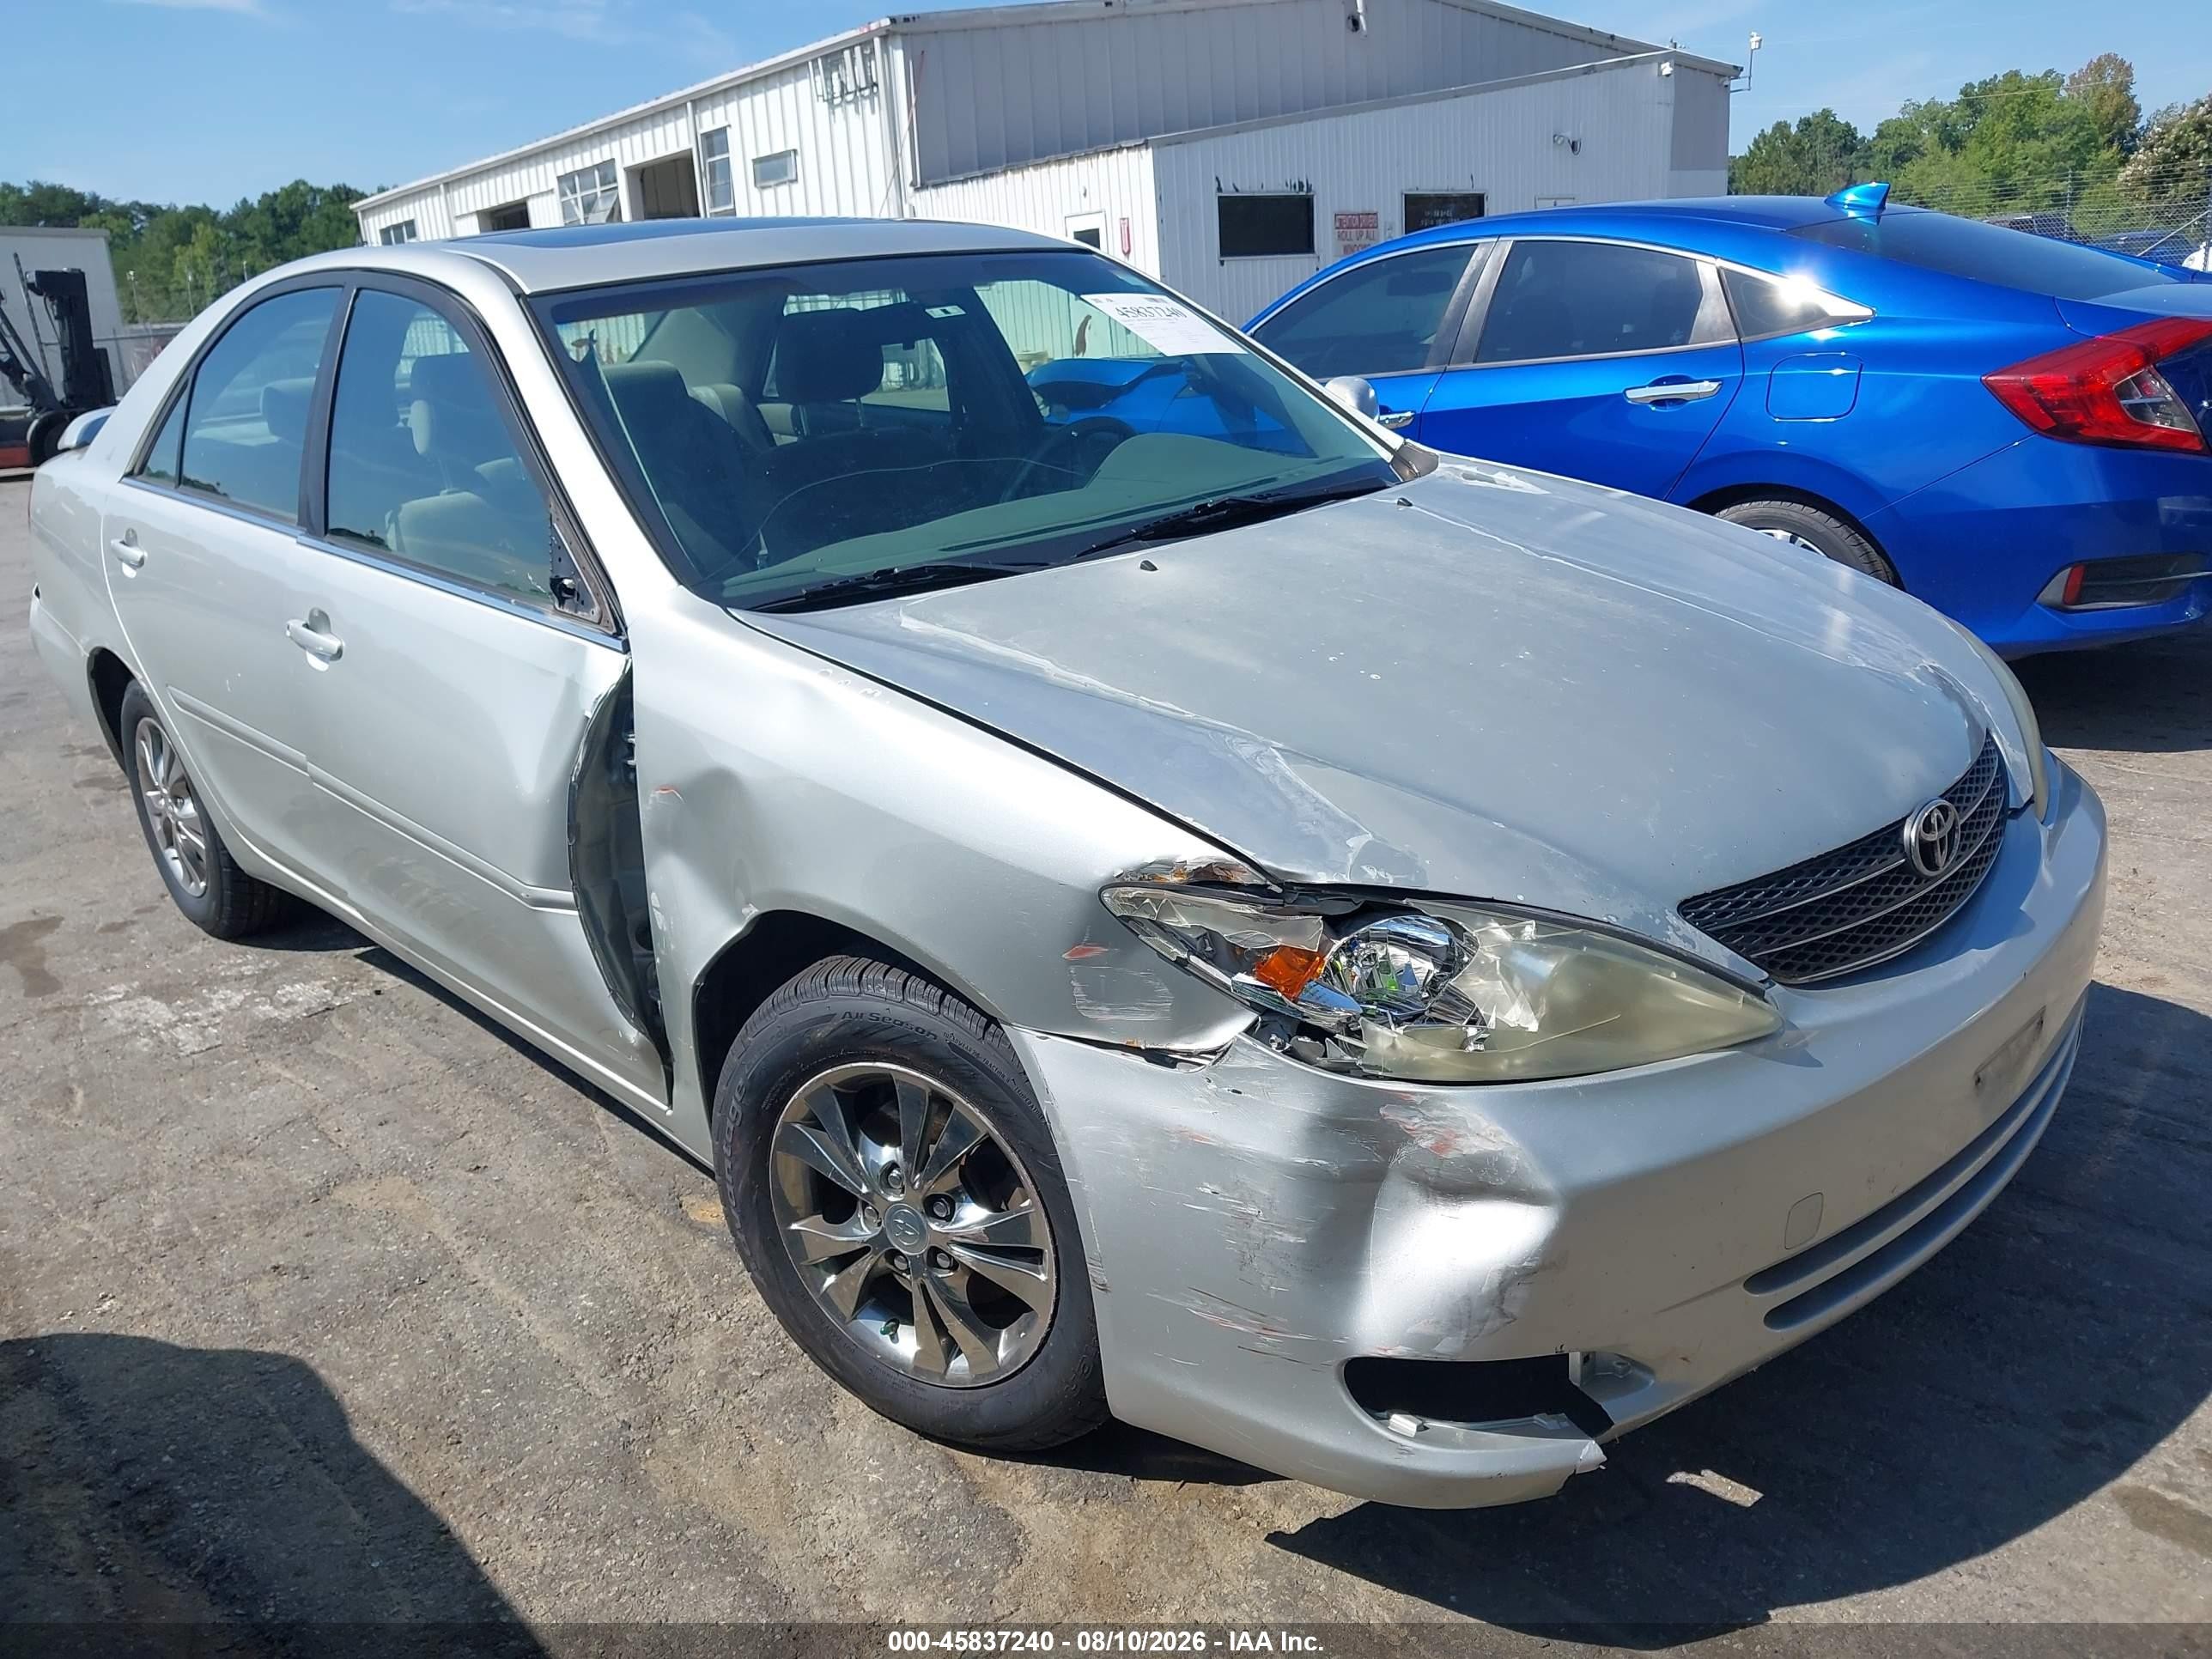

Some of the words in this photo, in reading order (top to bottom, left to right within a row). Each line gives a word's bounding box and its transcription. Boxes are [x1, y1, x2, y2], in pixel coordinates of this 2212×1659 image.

[1337, 230, 1353, 241] ROLL
[841, 1010, 864, 1020] All
[867, 1012, 939, 1042] Season
